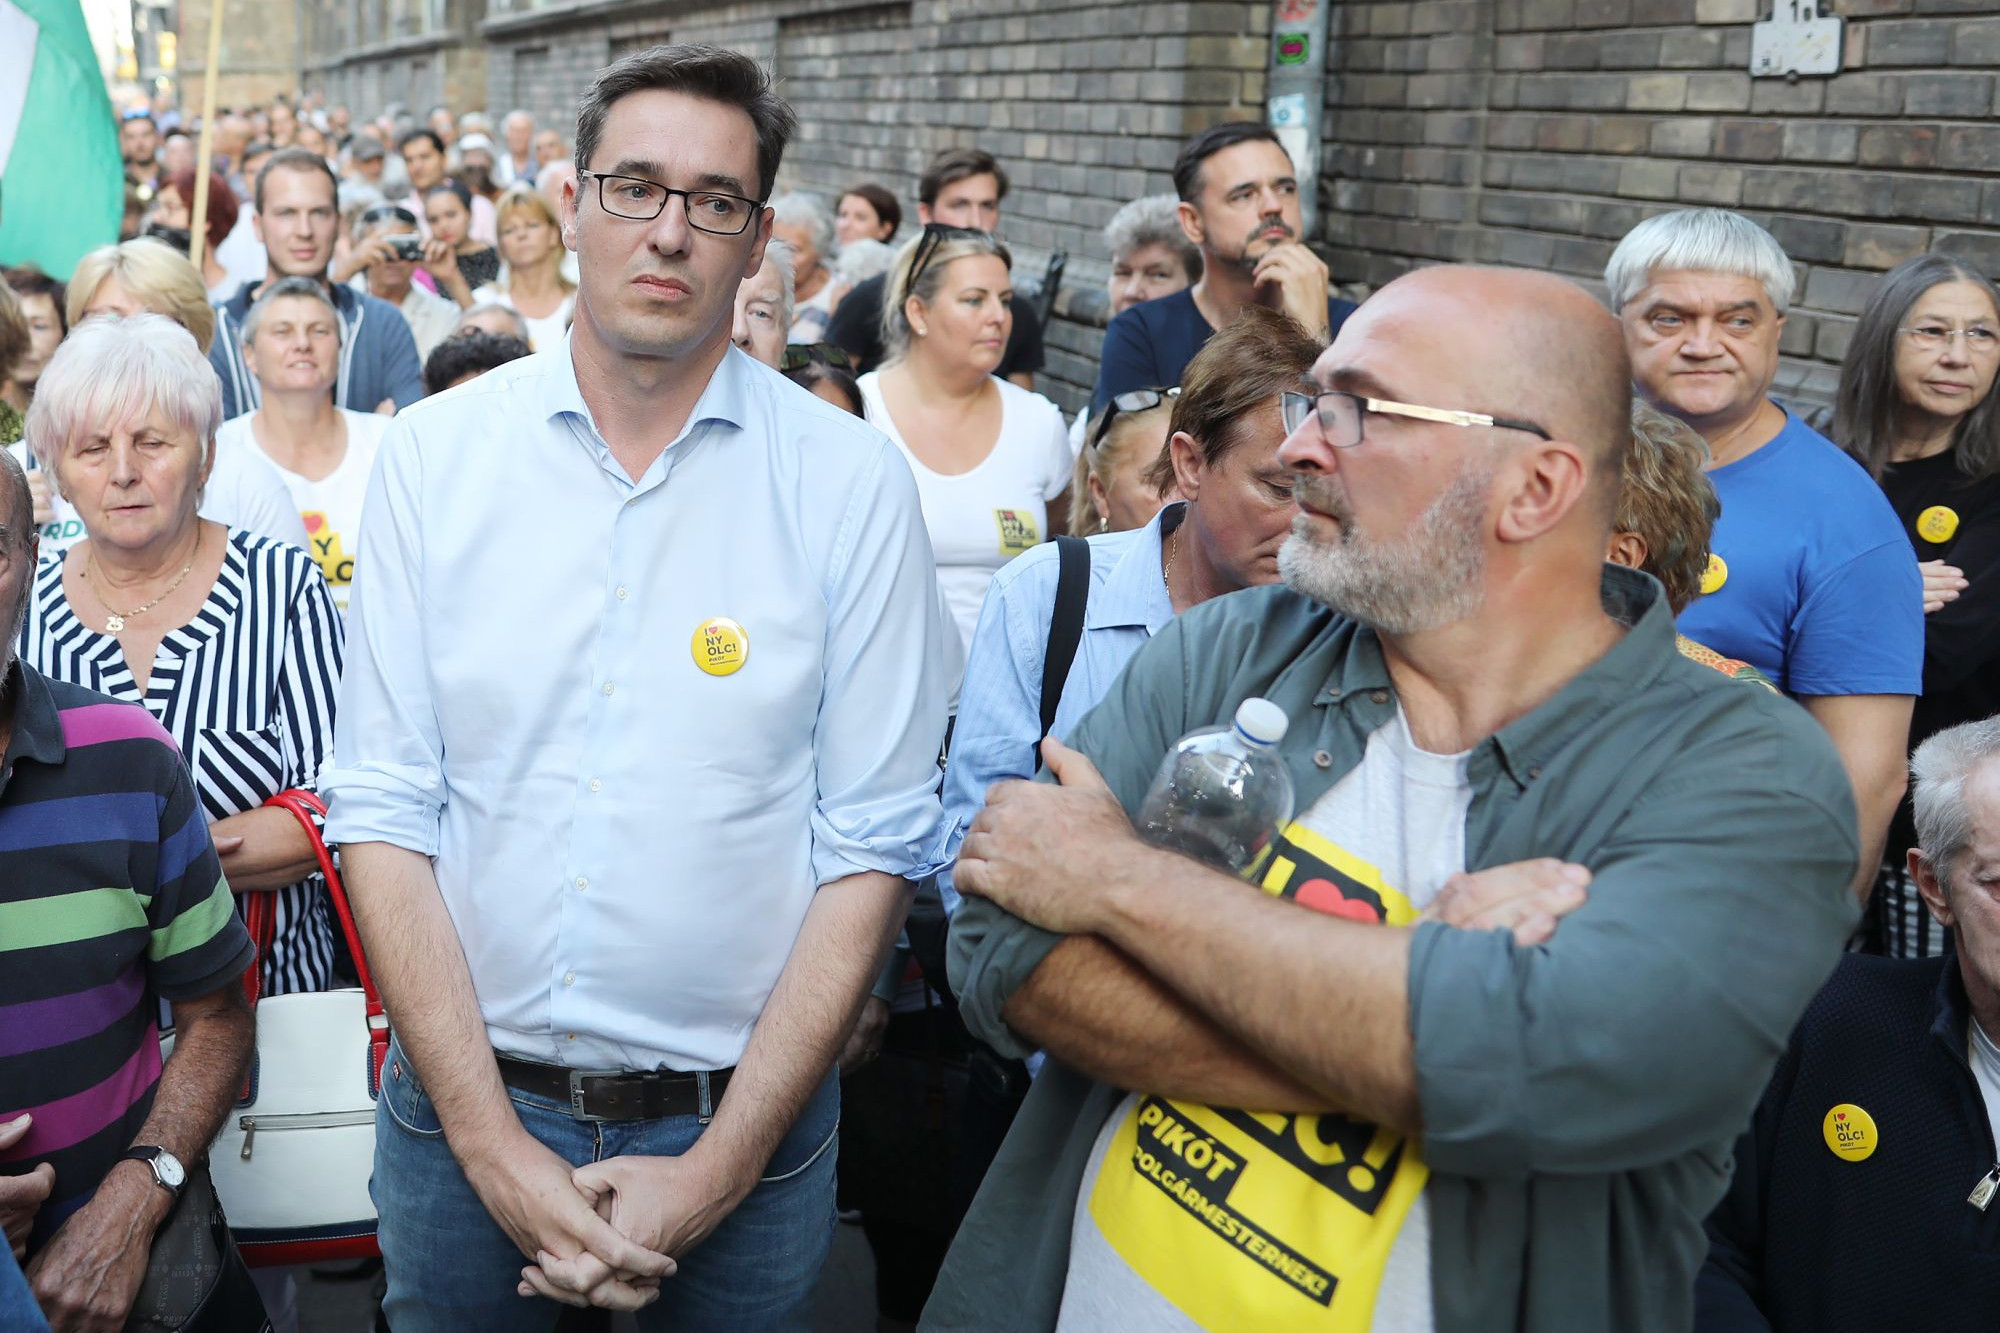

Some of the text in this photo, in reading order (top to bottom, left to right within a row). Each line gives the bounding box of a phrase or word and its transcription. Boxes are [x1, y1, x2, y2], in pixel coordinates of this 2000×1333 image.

[705, 635, 722, 646] NY
[707, 643, 737, 656] OLC!
[1835, 1122, 1850, 1132] NY
[1837, 1130, 1865, 1141] OLC!
[1138, 1103, 1237, 1182] PIKÓT
